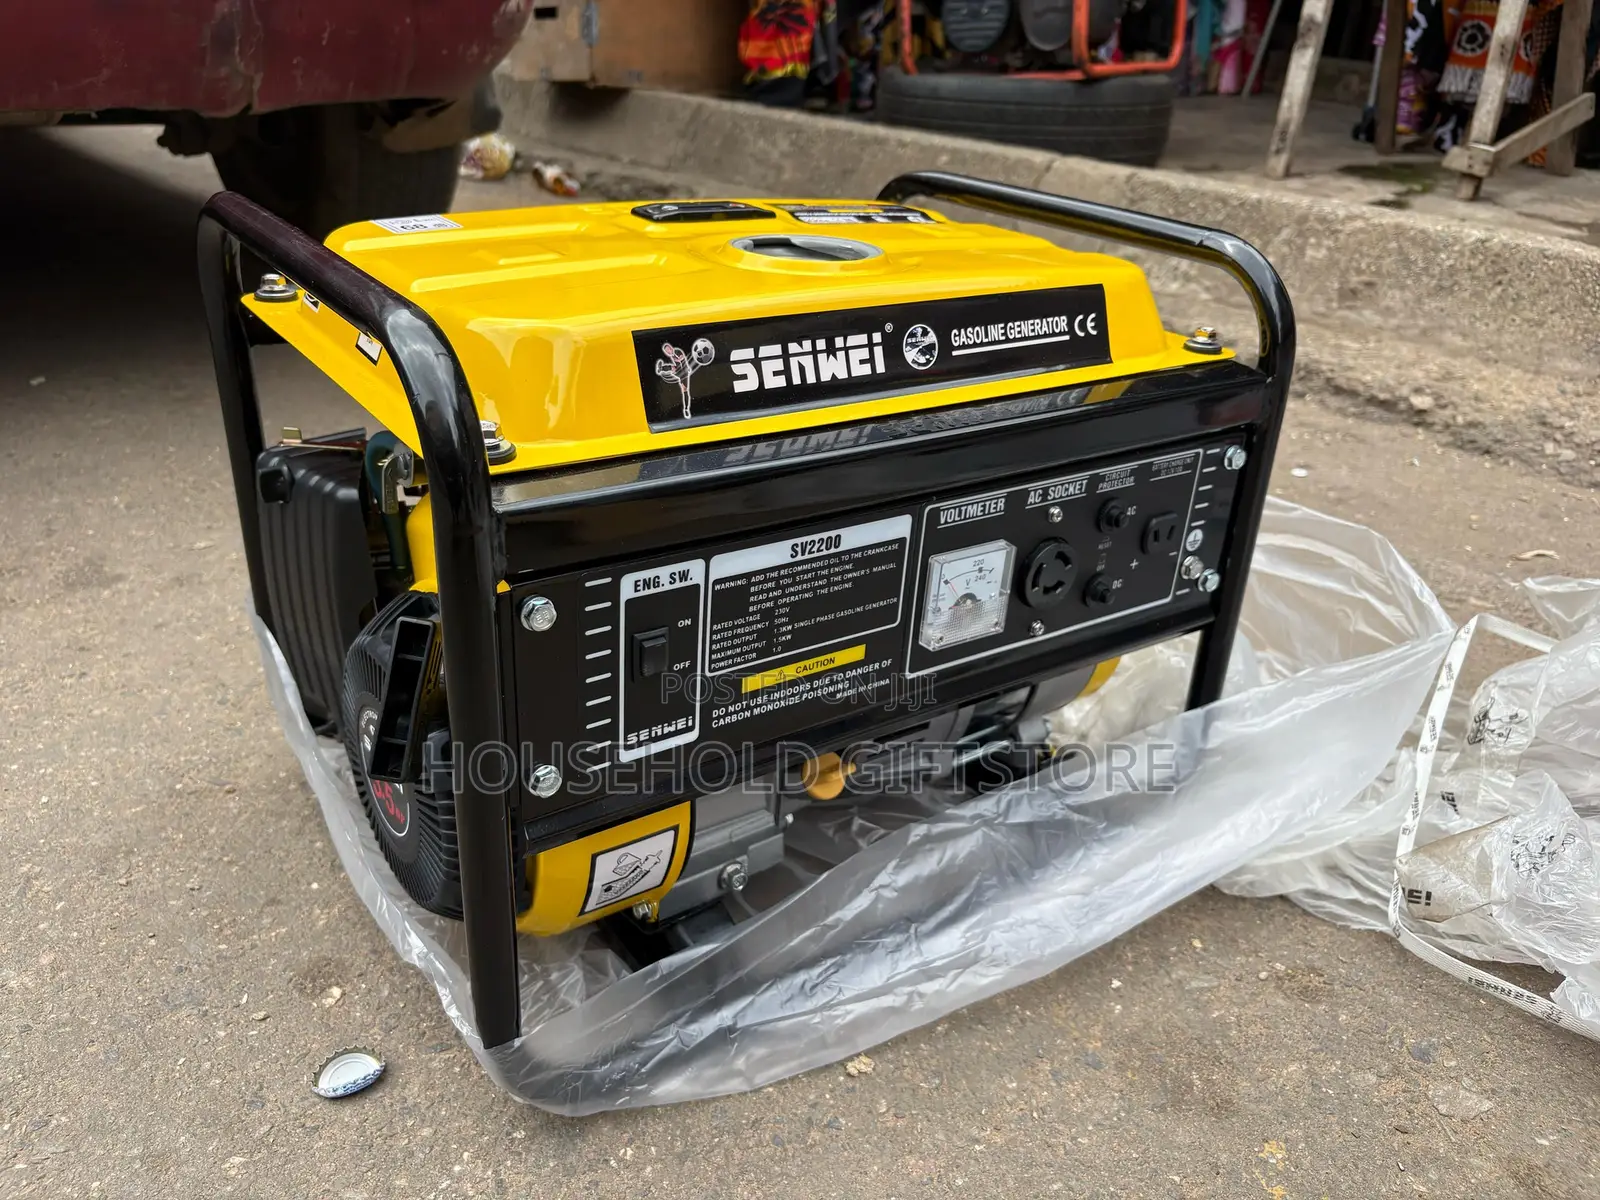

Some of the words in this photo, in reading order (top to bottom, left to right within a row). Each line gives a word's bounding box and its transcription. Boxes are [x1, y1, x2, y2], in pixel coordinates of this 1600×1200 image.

[951, 323, 1005, 347] GASOLINE
[1007, 315, 1068, 339] GENERATOR
[730, 332, 885, 393] SENWEI
[1098, 476, 1135, 490] PROTECTOR
[1105, 470, 1131, 481] CIRCUIT
[1027, 490, 1042, 504] AC
[1047, 480, 1087, 500] SOCKET
[940, 498, 1005, 524] VOLTMETER
[1127, 506, 1137, 515] AC
[790, 534, 842, 559] SV2200
[715, 578, 748, 590] WARNING:
[751, 572, 765, 582] ADD
[766, 568, 779, 578] THE
[780, 560, 829, 576] RECOMMENDED
[830, 557, 839, 565] OIL
[841, 554, 850, 562] TO
[851, 551, 862, 559] THE
[864, 543, 899, 557] CRANKCASE
[973, 559, 985, 567] 220
[634, 576, 664, 593] ENG.
[669, 569, 693, 585] SW.
[750, 581, 776, 593] BEFORE
[780, 577, 792, 586] YOU
[796, 572, 815, 582] START
[817, 568, 829, 576] THE
[750, 592, 768, 602] READ
[768, 589, 782, 599] AND
[785, 578, 827, 594] UNDERSTAND
[830, 575, 842, 583] THE
[844, 568, 870, 580] OWNER'S
[873, 562, 897, 573] MANUAL
[974, 574, 986, 582] 240
[1112, 579, 1123, 589] DC
[749, 601, 774, 612] BEFORE
[777, 591, 814, 605] OPERATING
[816, 588, 829, 596] THE
[677, 619, 692, 628] ON
[712, 640, 732, 650] RATED
[733, 634, 757, 645] OUTPUT
[794, 618, 815, 628] SINGLE
[816, 613, 835, 624] PHASE
[836, 606, 864, 618] GASOLINE
[865, 597, 897, 610] GENERATOR
[712, 630, 732, 640] RATED
[733, 621, 769, 635] FREQUENCY
[774, 616, 789, 625] 50Hz
[713, 620, 733, 631] RATED
[734, 613, 760, 625] VOLTAGE
[774, 606, 790, 616] 230V
[711, 648, 741, 660] MAXIMUM
[742, 640, 767, 652] OUTPUT
[711, 659, 733, 669] POWER
[734, 652, 757, 664] FACTOR
[673, 660, 691, 671] OFF
[795, 657, 836, 675] CAUTION
[712, 707, 725, 718] DO
[728, 701, 747, 713] NOT
[750, 695, 768, 706] USE
[770, 682, 811, 700] INDOORS
[813, 678, 830, 687] DUE
[833, 673, 843, 682] TO
[845, 662, 879, 678] DANGER
[881, 658, 893, 668] OF
[836, 688, 857, 699] MADE
[858, 685, 866, 693] IN
[867, 678, 890, 689] CHINA
[712, 711, 751, 728] CARBON
[753, 697, 800, 716] MONOXIDE
[802, 681, 849, 700] POISONING
[627, 716, 693, 745] SENWEI
